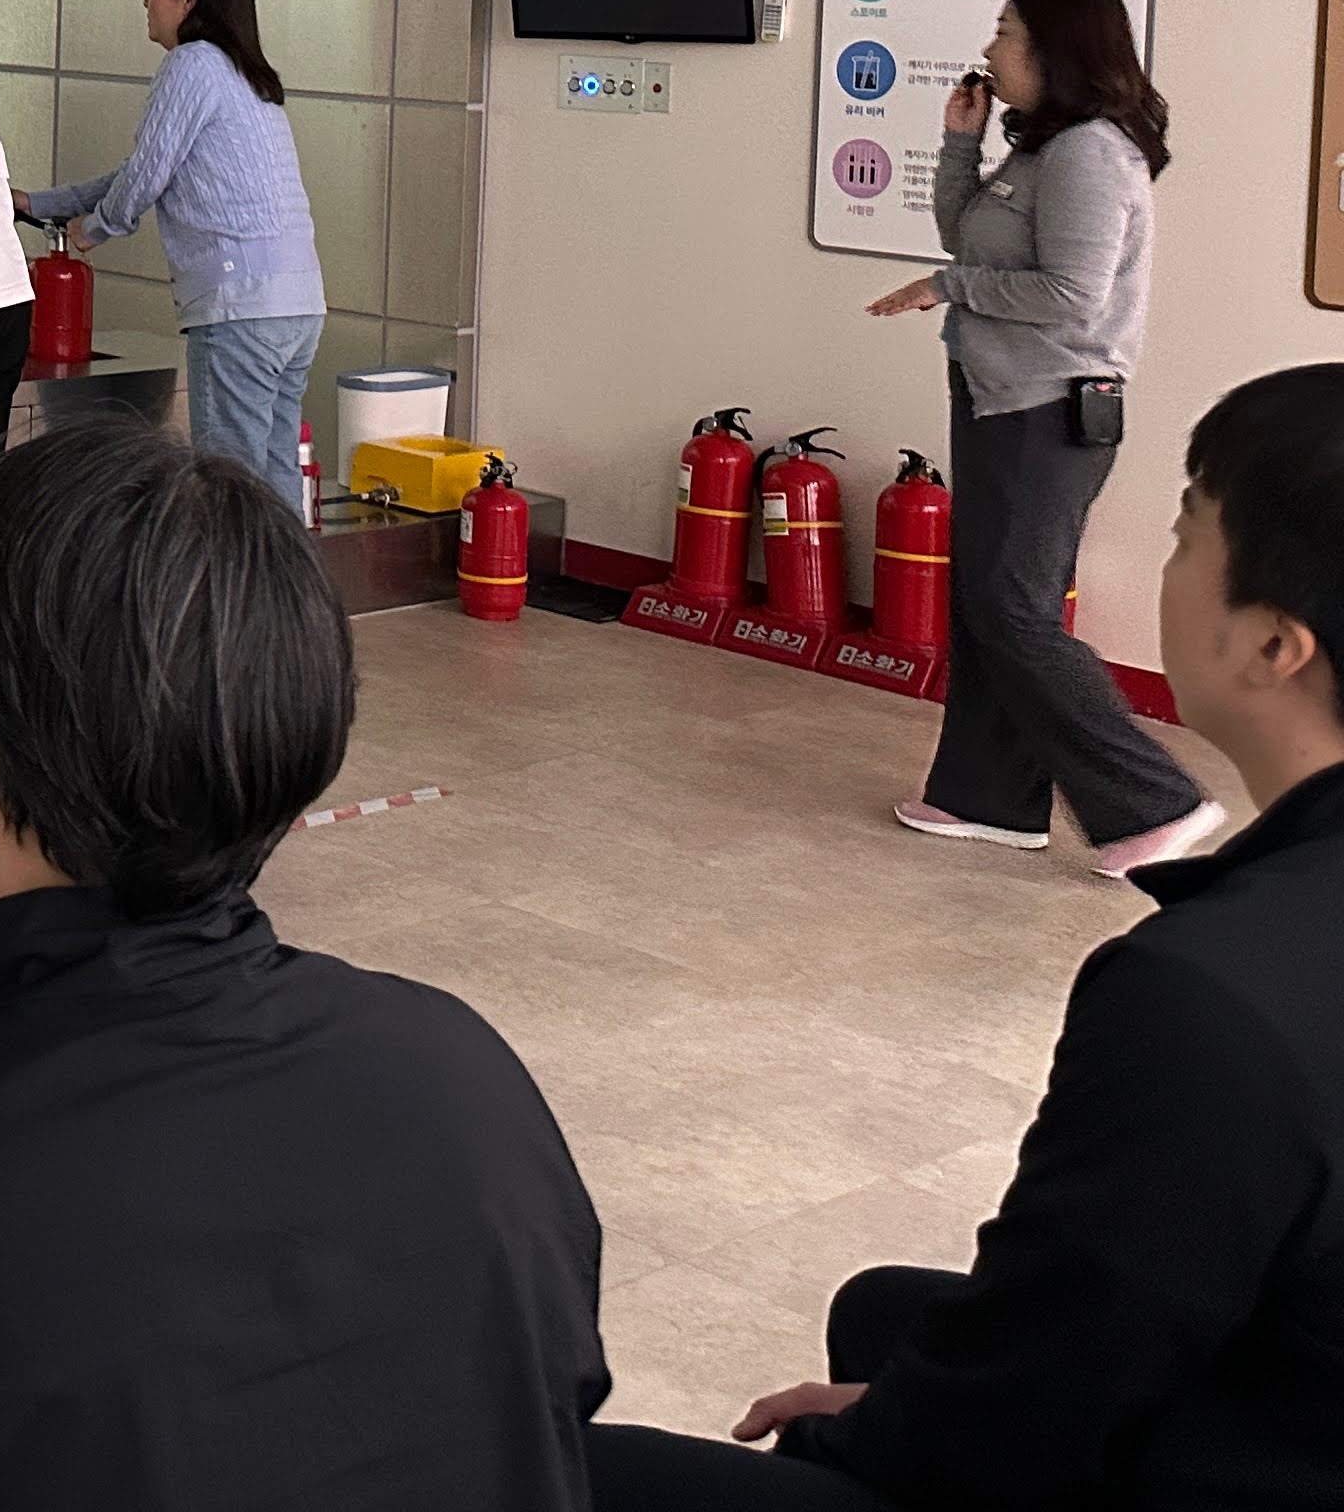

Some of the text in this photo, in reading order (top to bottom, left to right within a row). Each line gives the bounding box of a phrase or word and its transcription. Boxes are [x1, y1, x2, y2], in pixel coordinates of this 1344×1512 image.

[845, 104, 886, 118] 유리 비커
[654, 600, 709, 625] 소화기
[749, 624, 808, 651] 소화기
[854, 650, 915, 677] 소화기
